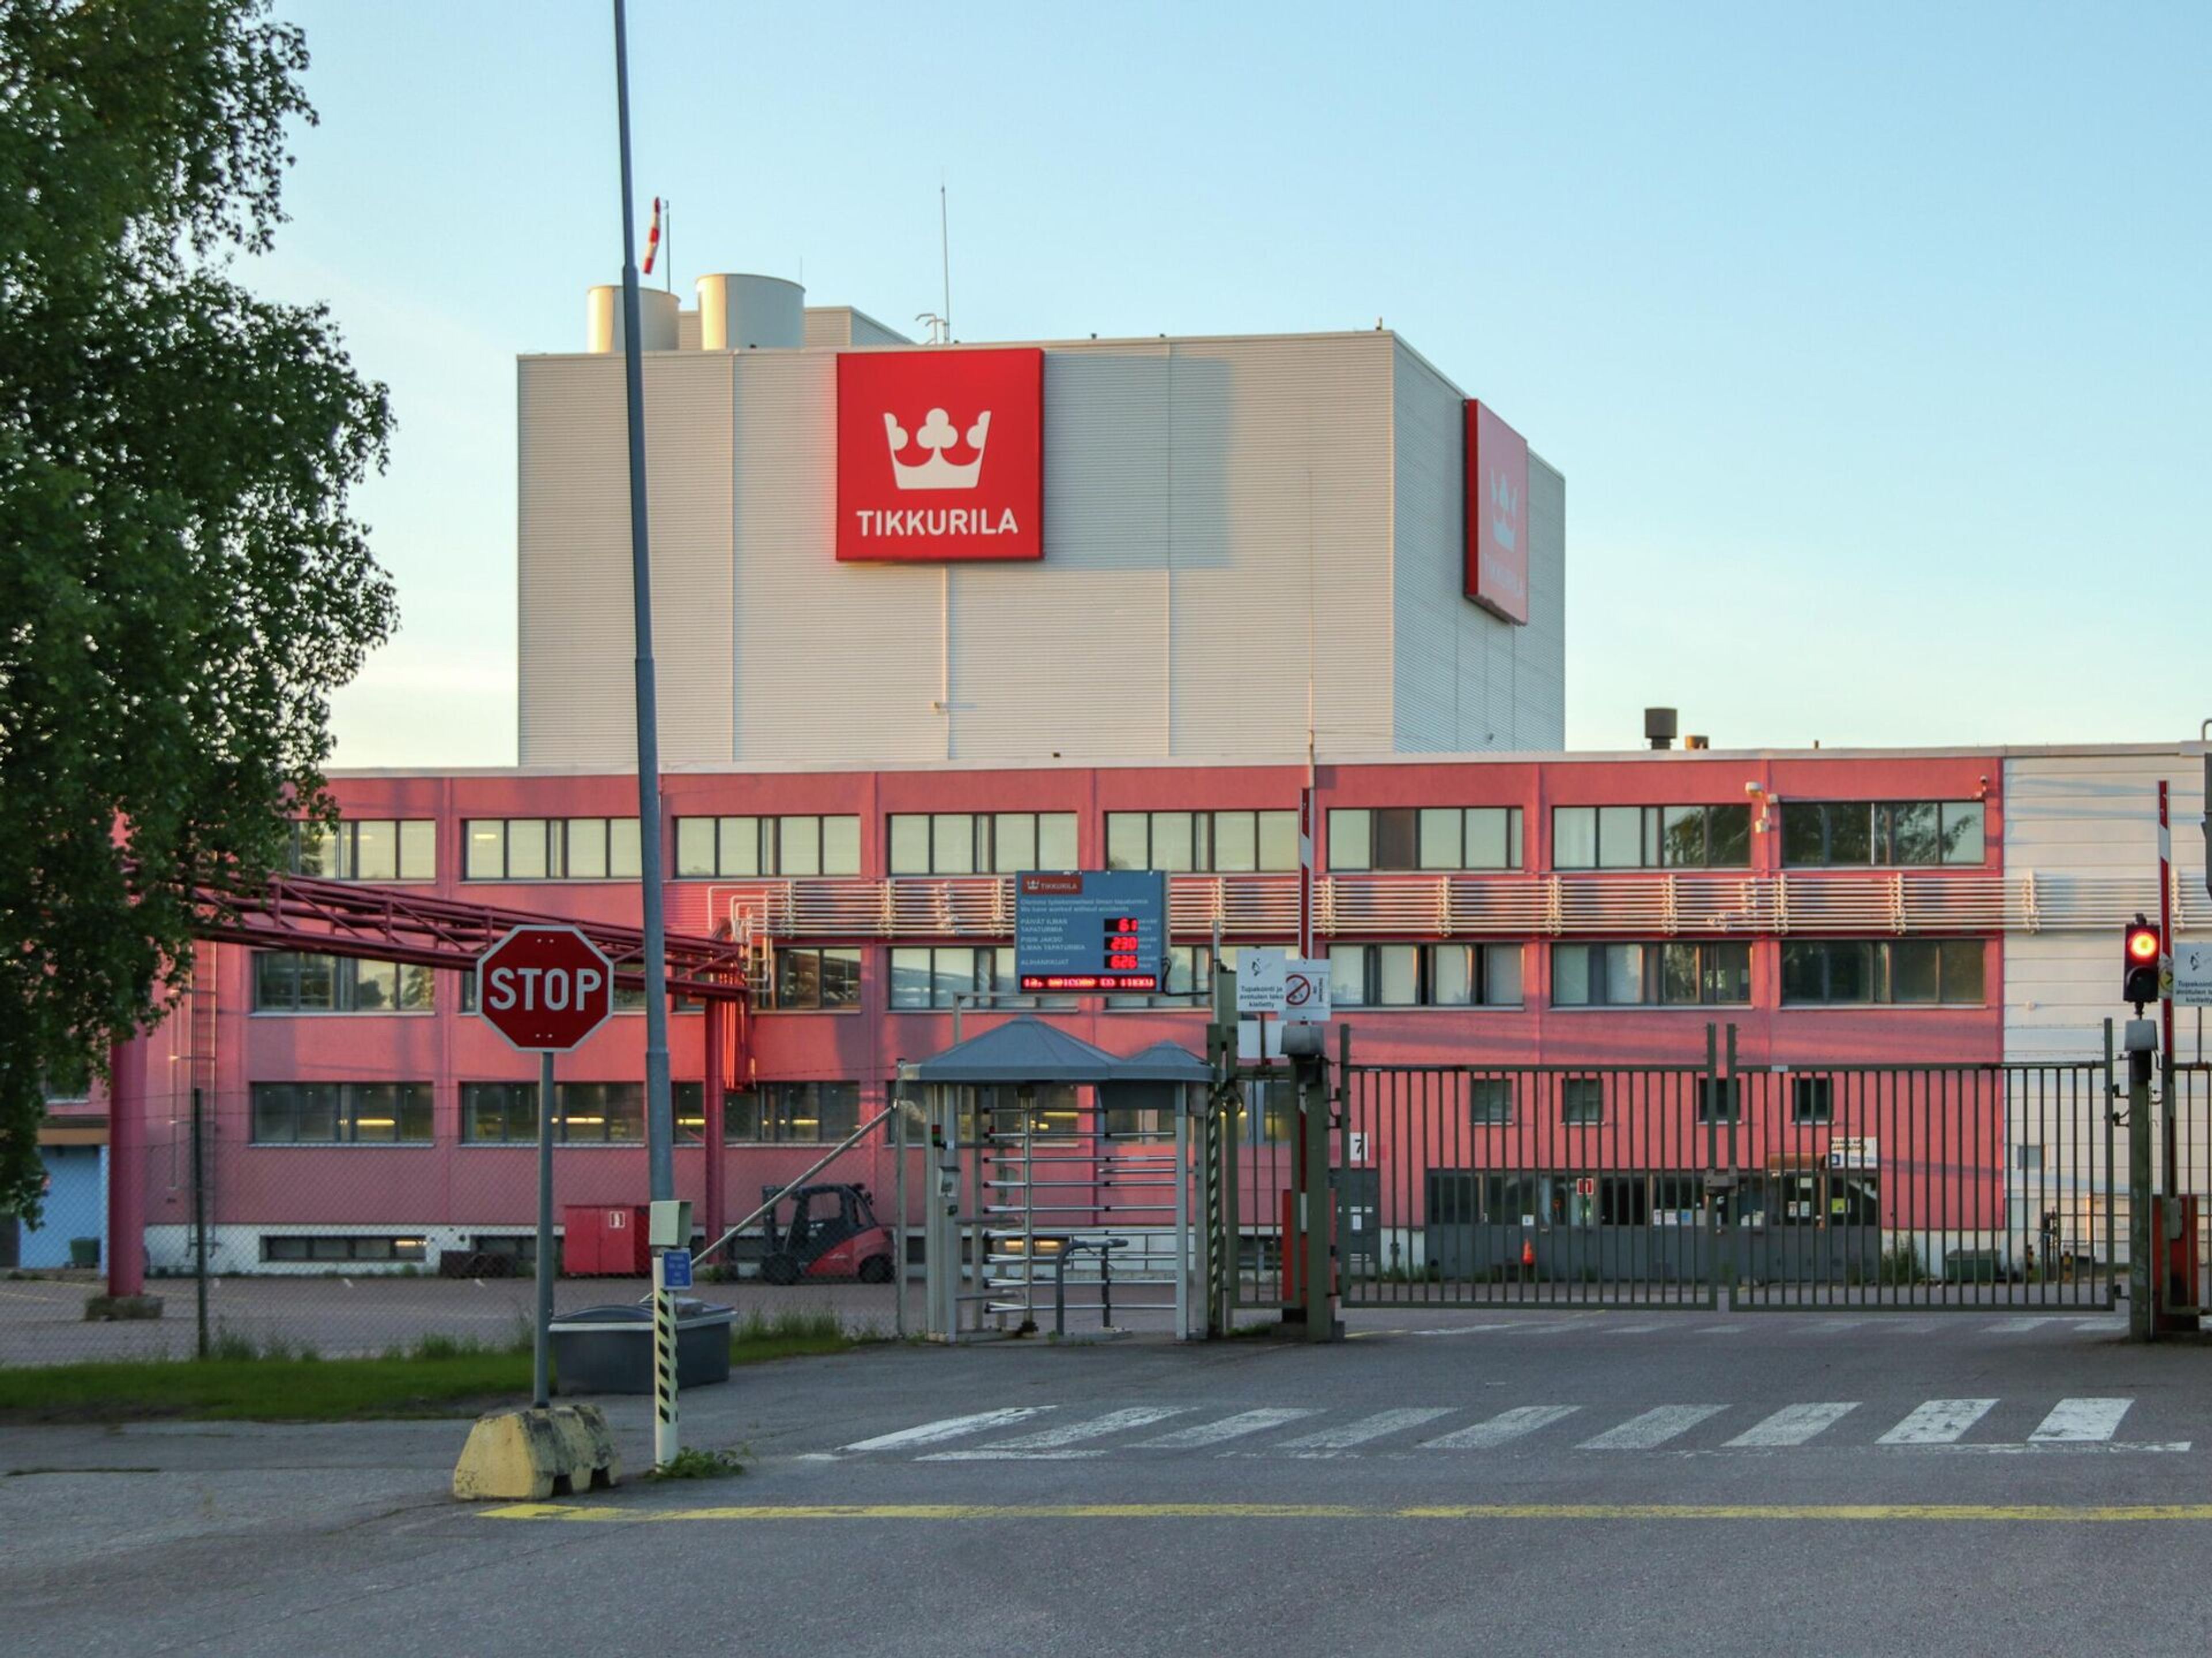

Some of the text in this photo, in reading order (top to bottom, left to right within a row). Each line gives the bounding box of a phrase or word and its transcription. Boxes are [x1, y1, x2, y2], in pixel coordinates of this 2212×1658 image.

[857, 508, 1018, 536] TIKKURILA
[490, 967, 602, 1010] STOP
[1355, 1139, 1363, 1154] 7
